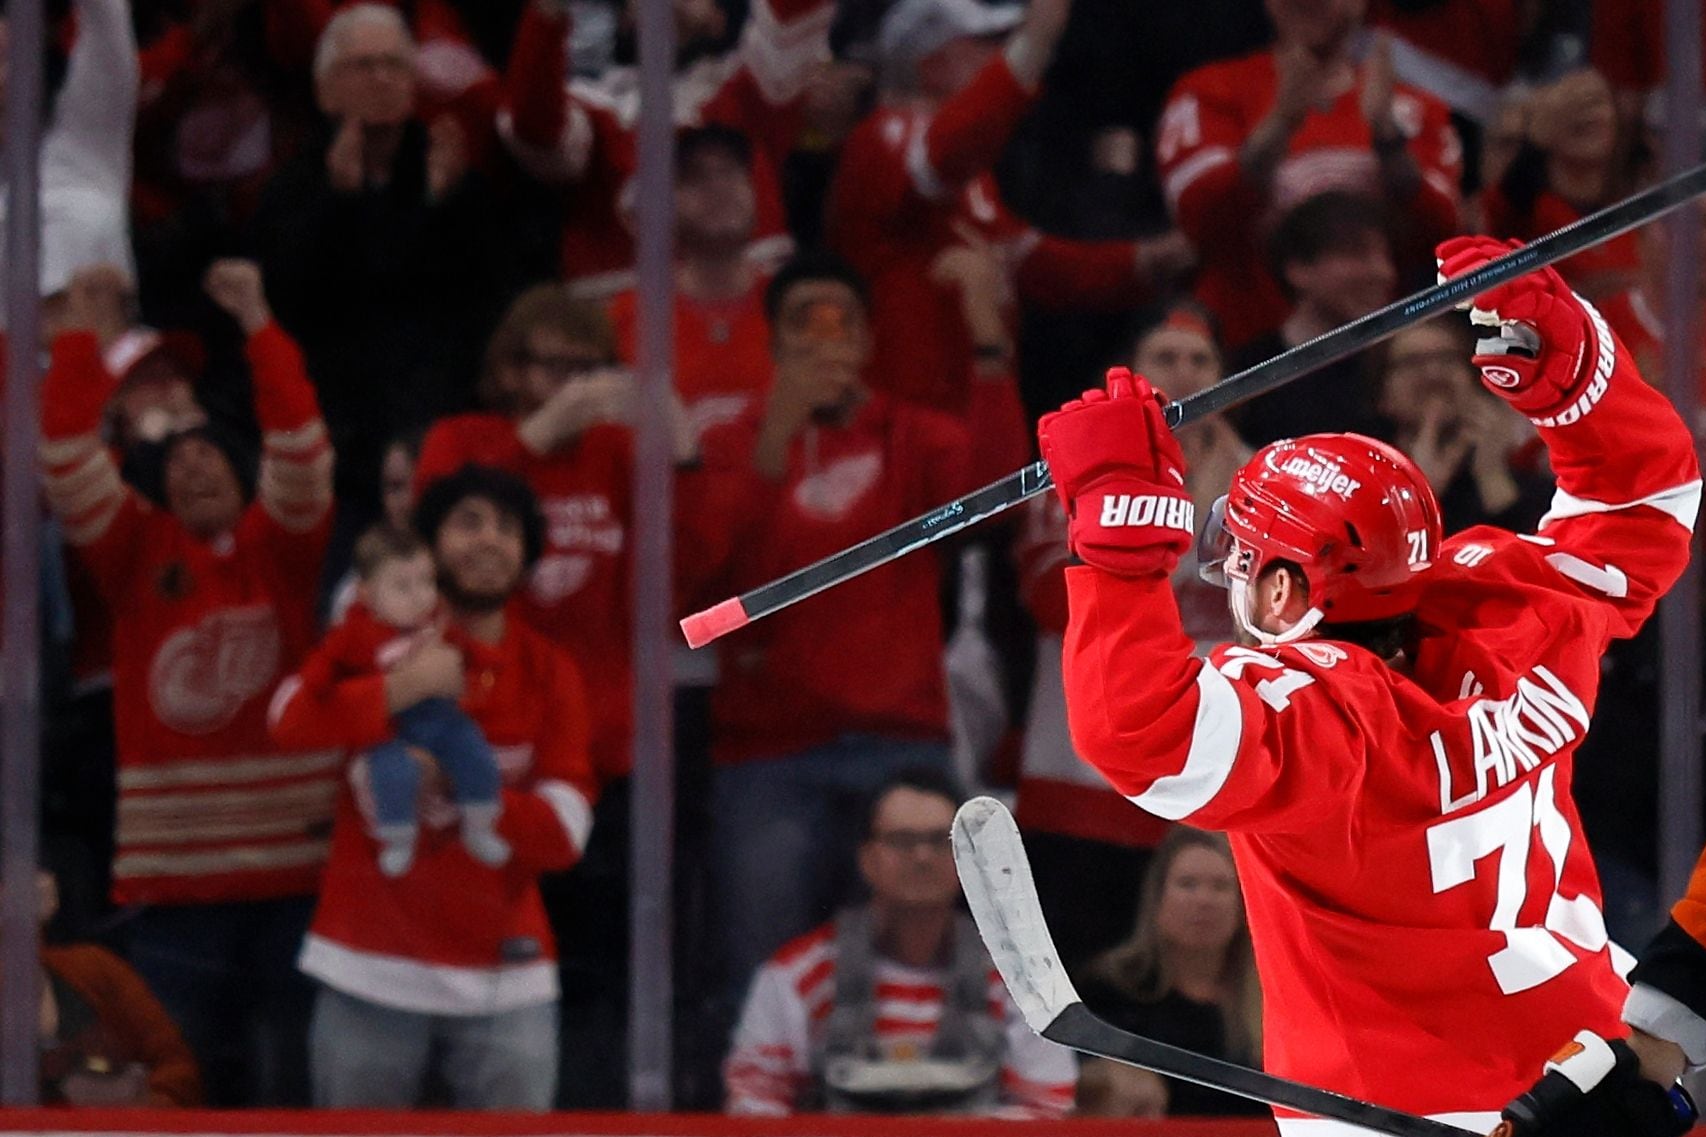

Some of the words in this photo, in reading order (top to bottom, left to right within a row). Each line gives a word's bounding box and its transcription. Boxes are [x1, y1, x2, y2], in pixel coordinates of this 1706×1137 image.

[1285, 457, 1361, 498] meijer
[1407, 529, 1427, 567] 71
[1430, 664, 1590, 815] LARKIN
[1427, 762, 1610, 995] 71
